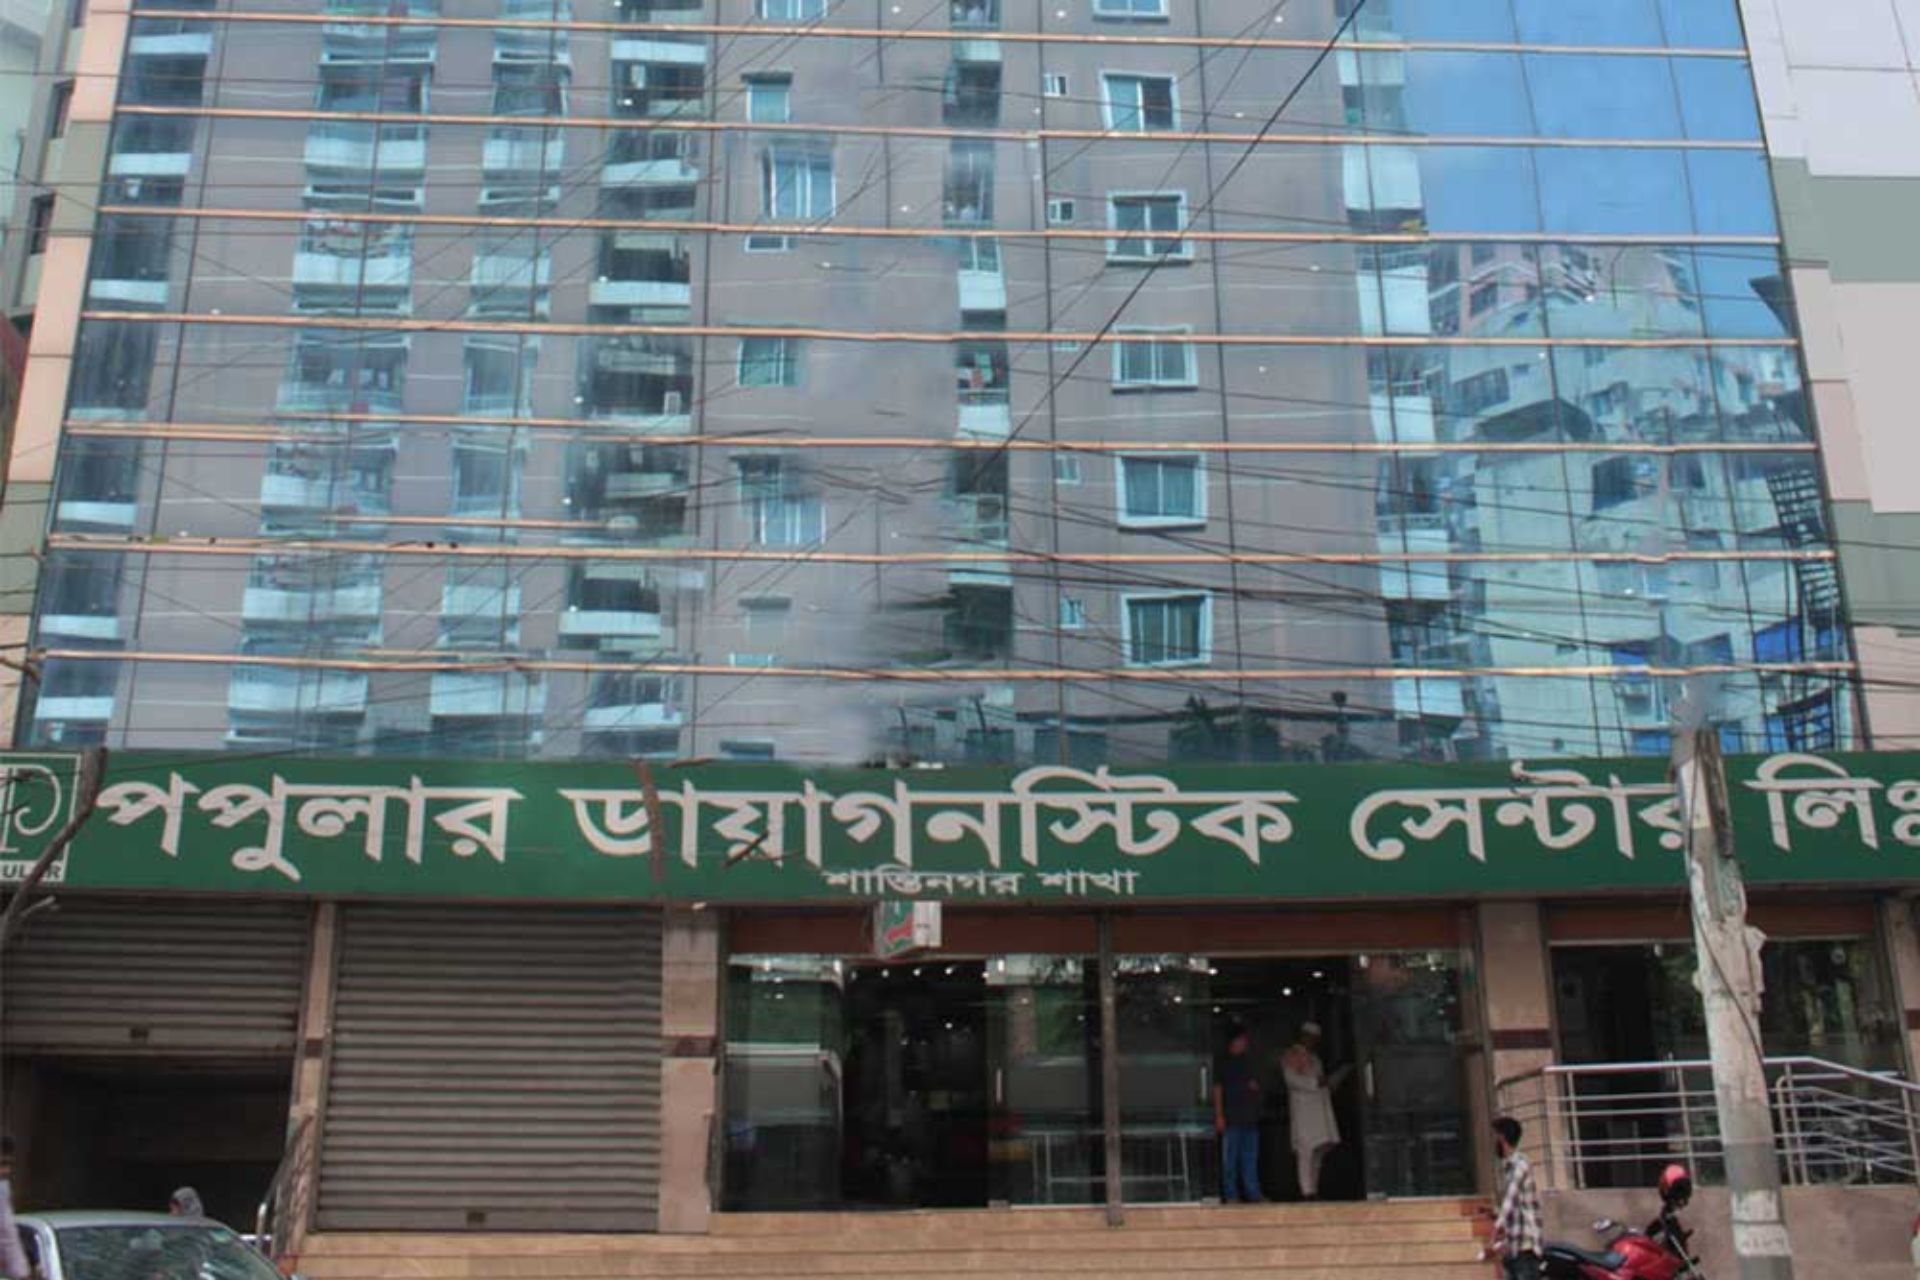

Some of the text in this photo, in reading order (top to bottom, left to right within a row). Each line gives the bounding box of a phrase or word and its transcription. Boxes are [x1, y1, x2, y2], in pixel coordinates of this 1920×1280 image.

[96, 772, 525, 881] পপুলার
[559, 765, 1298, 867] ডায়াগনস্টিক
[821, 863, 1140, 896] শান্তিনগর শাখা
